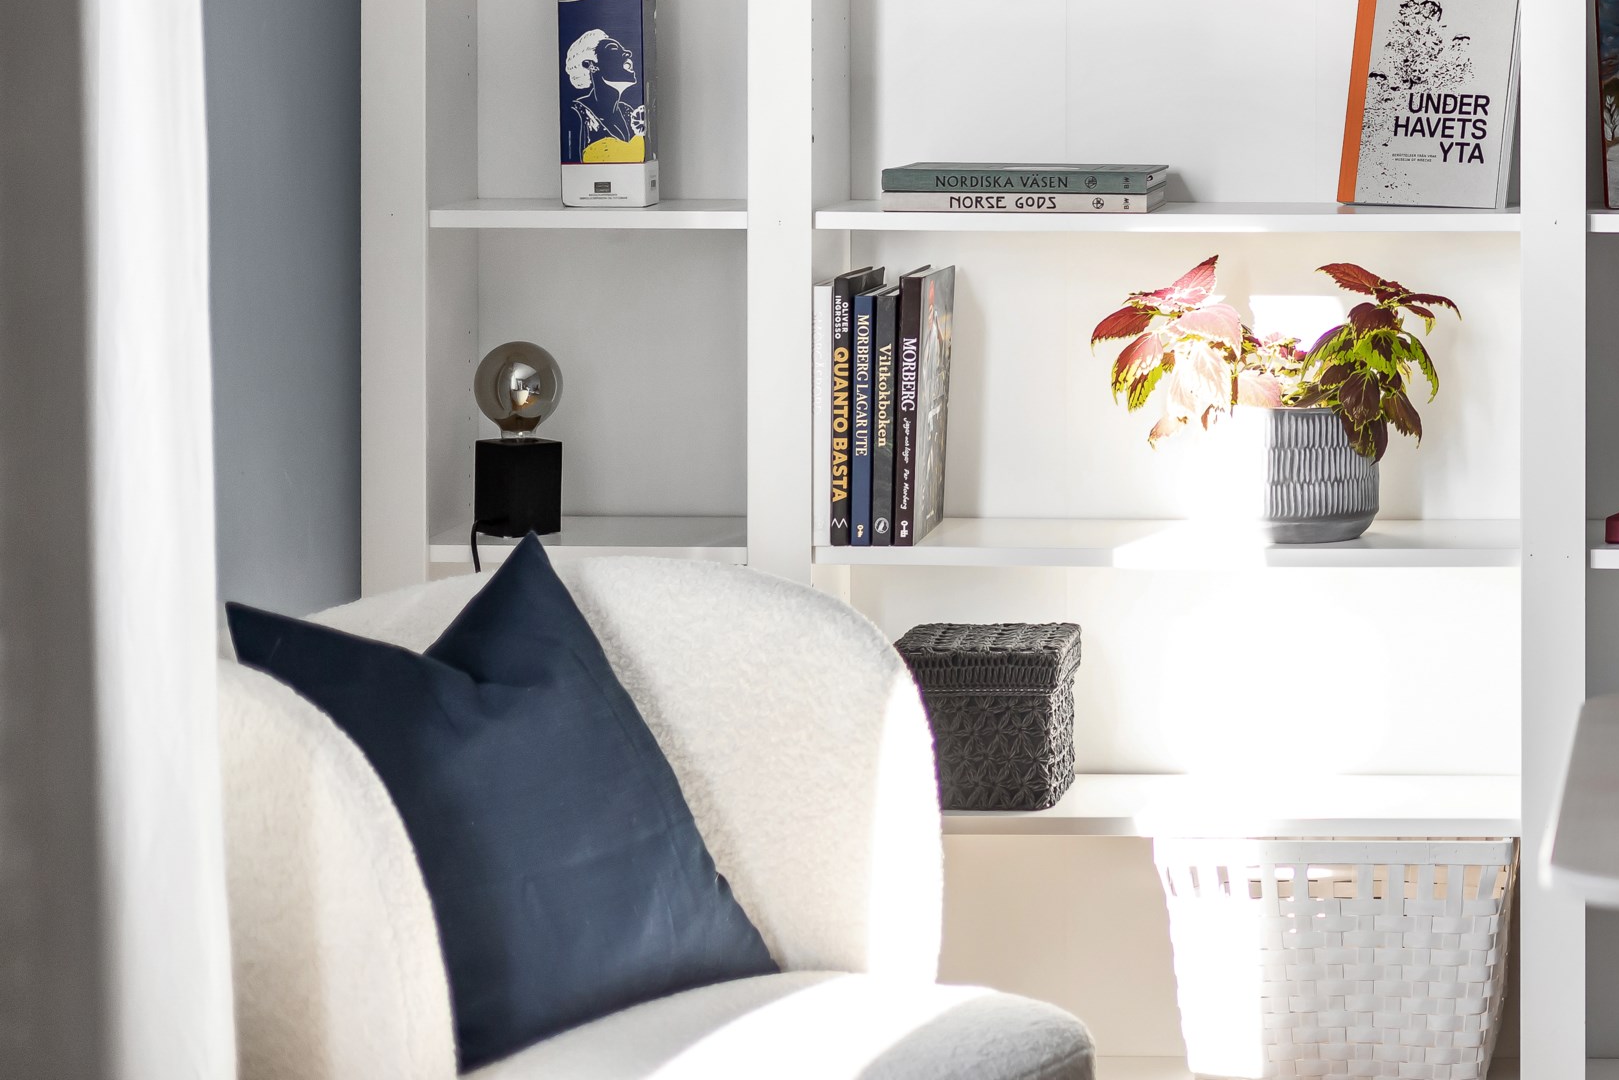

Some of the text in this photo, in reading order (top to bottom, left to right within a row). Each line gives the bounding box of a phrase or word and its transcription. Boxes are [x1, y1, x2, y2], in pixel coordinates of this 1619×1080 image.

[1408, 93, 1490, 116] UNDER
[1393, 116, 1487, 140] HAVETS
[1439, 141, 1484, 164] YTA
[935, 173, 1068, 189] NORDISKA VÄSEN
[949, 196, 1057, 209] NORSE GODS
[834, 295, 842, 340] INGROSSO
[855, 314, 869, 456] MORBERG LAGAR UTE
[901, 338, 917, 411] MORBERG
[878, 344, 892, 447] Viltkokboken
[832, 346, 849, 502] QUANTO BASTA
[900, 482, 910, 509] Morberg
